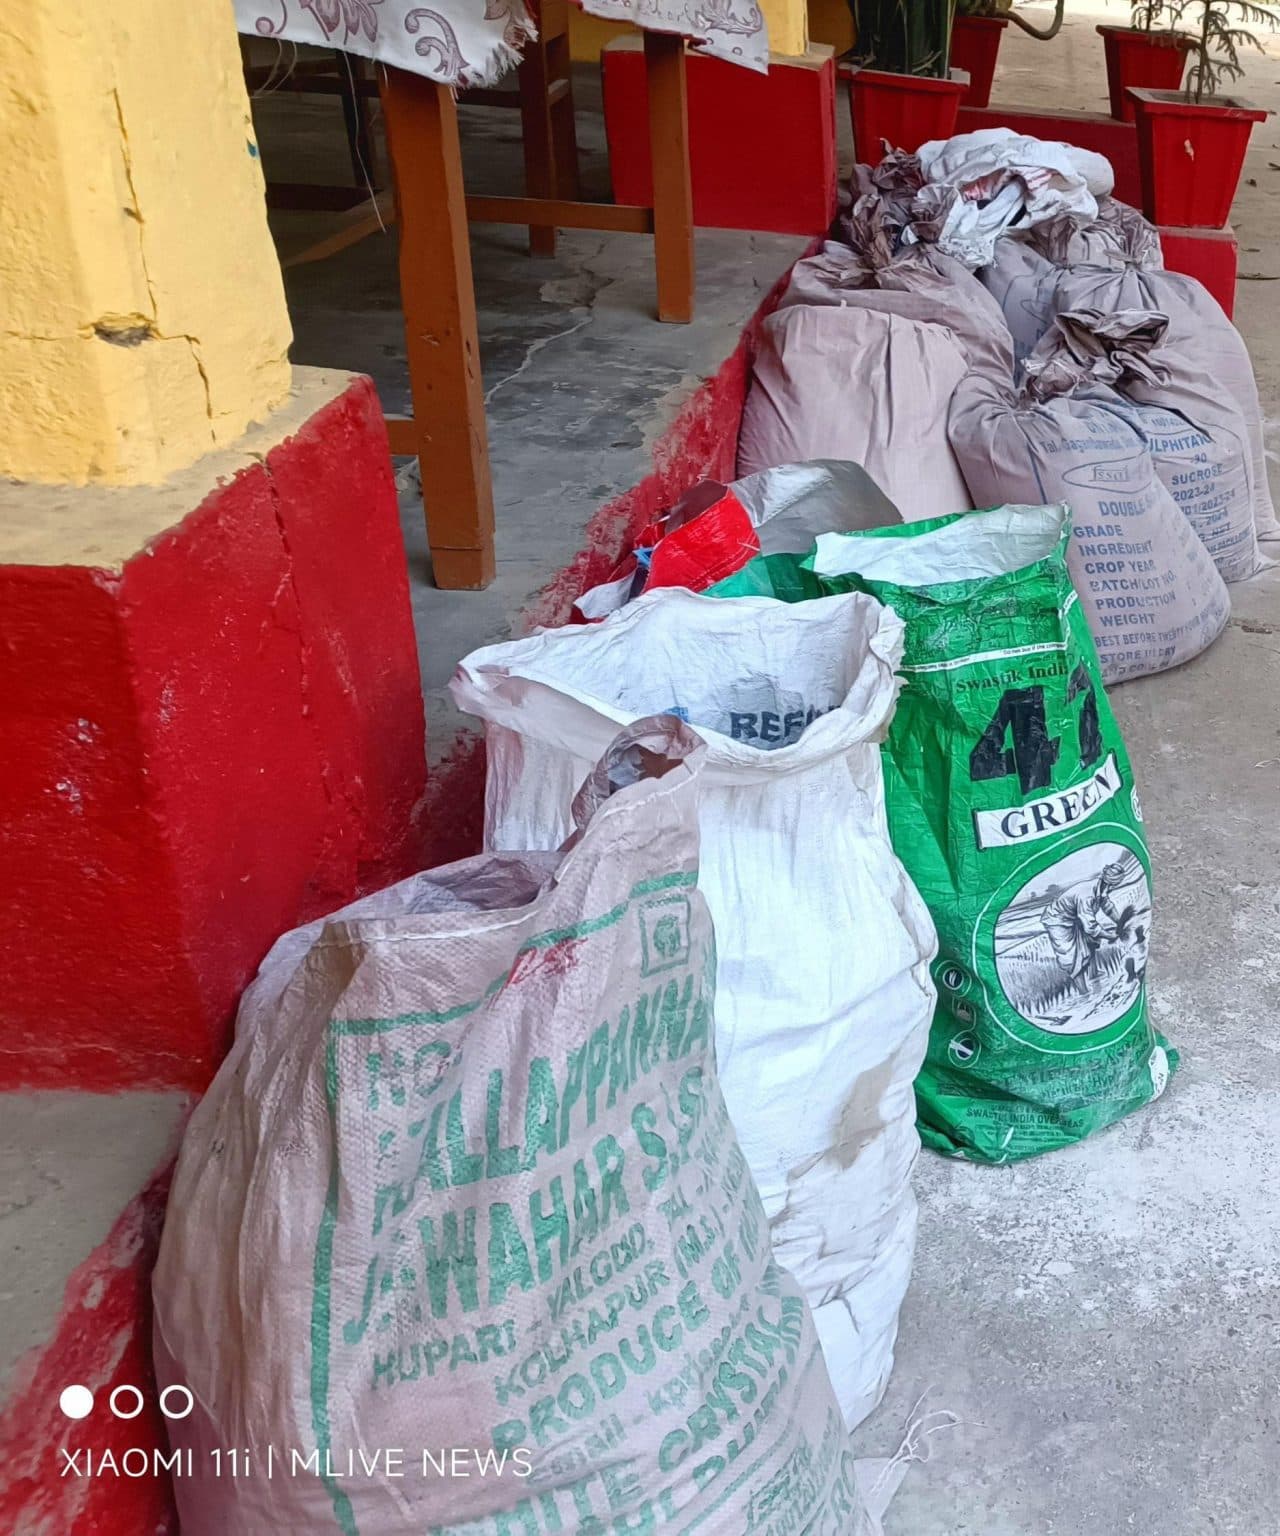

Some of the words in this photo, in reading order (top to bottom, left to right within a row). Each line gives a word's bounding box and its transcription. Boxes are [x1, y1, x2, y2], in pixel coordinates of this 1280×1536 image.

[1073, 525, 1123, 538] GRADE
[1079, 540, 1153, 557] INGREDIENT
[1085, 561, 1125, 575] CROP
[1129, 560, 1157, 573] YEAR
[1096, 591, 1177, 610] PRODUCTION
[1100, 613, 1156, 628] WEIGHT
[1095, 634, 1121, 648] BEST
[1123, 631, 1156, 645] BEFORE
[1101, 650, 1142, 664] STORE
[956, 670, 1022, 692] Swastik
[1001, 773, 1112, 839] GREEN
[495, 1258, 671, 1405] KOLHAPUR
[490, 1279, 711, 1452] PRODUCE
